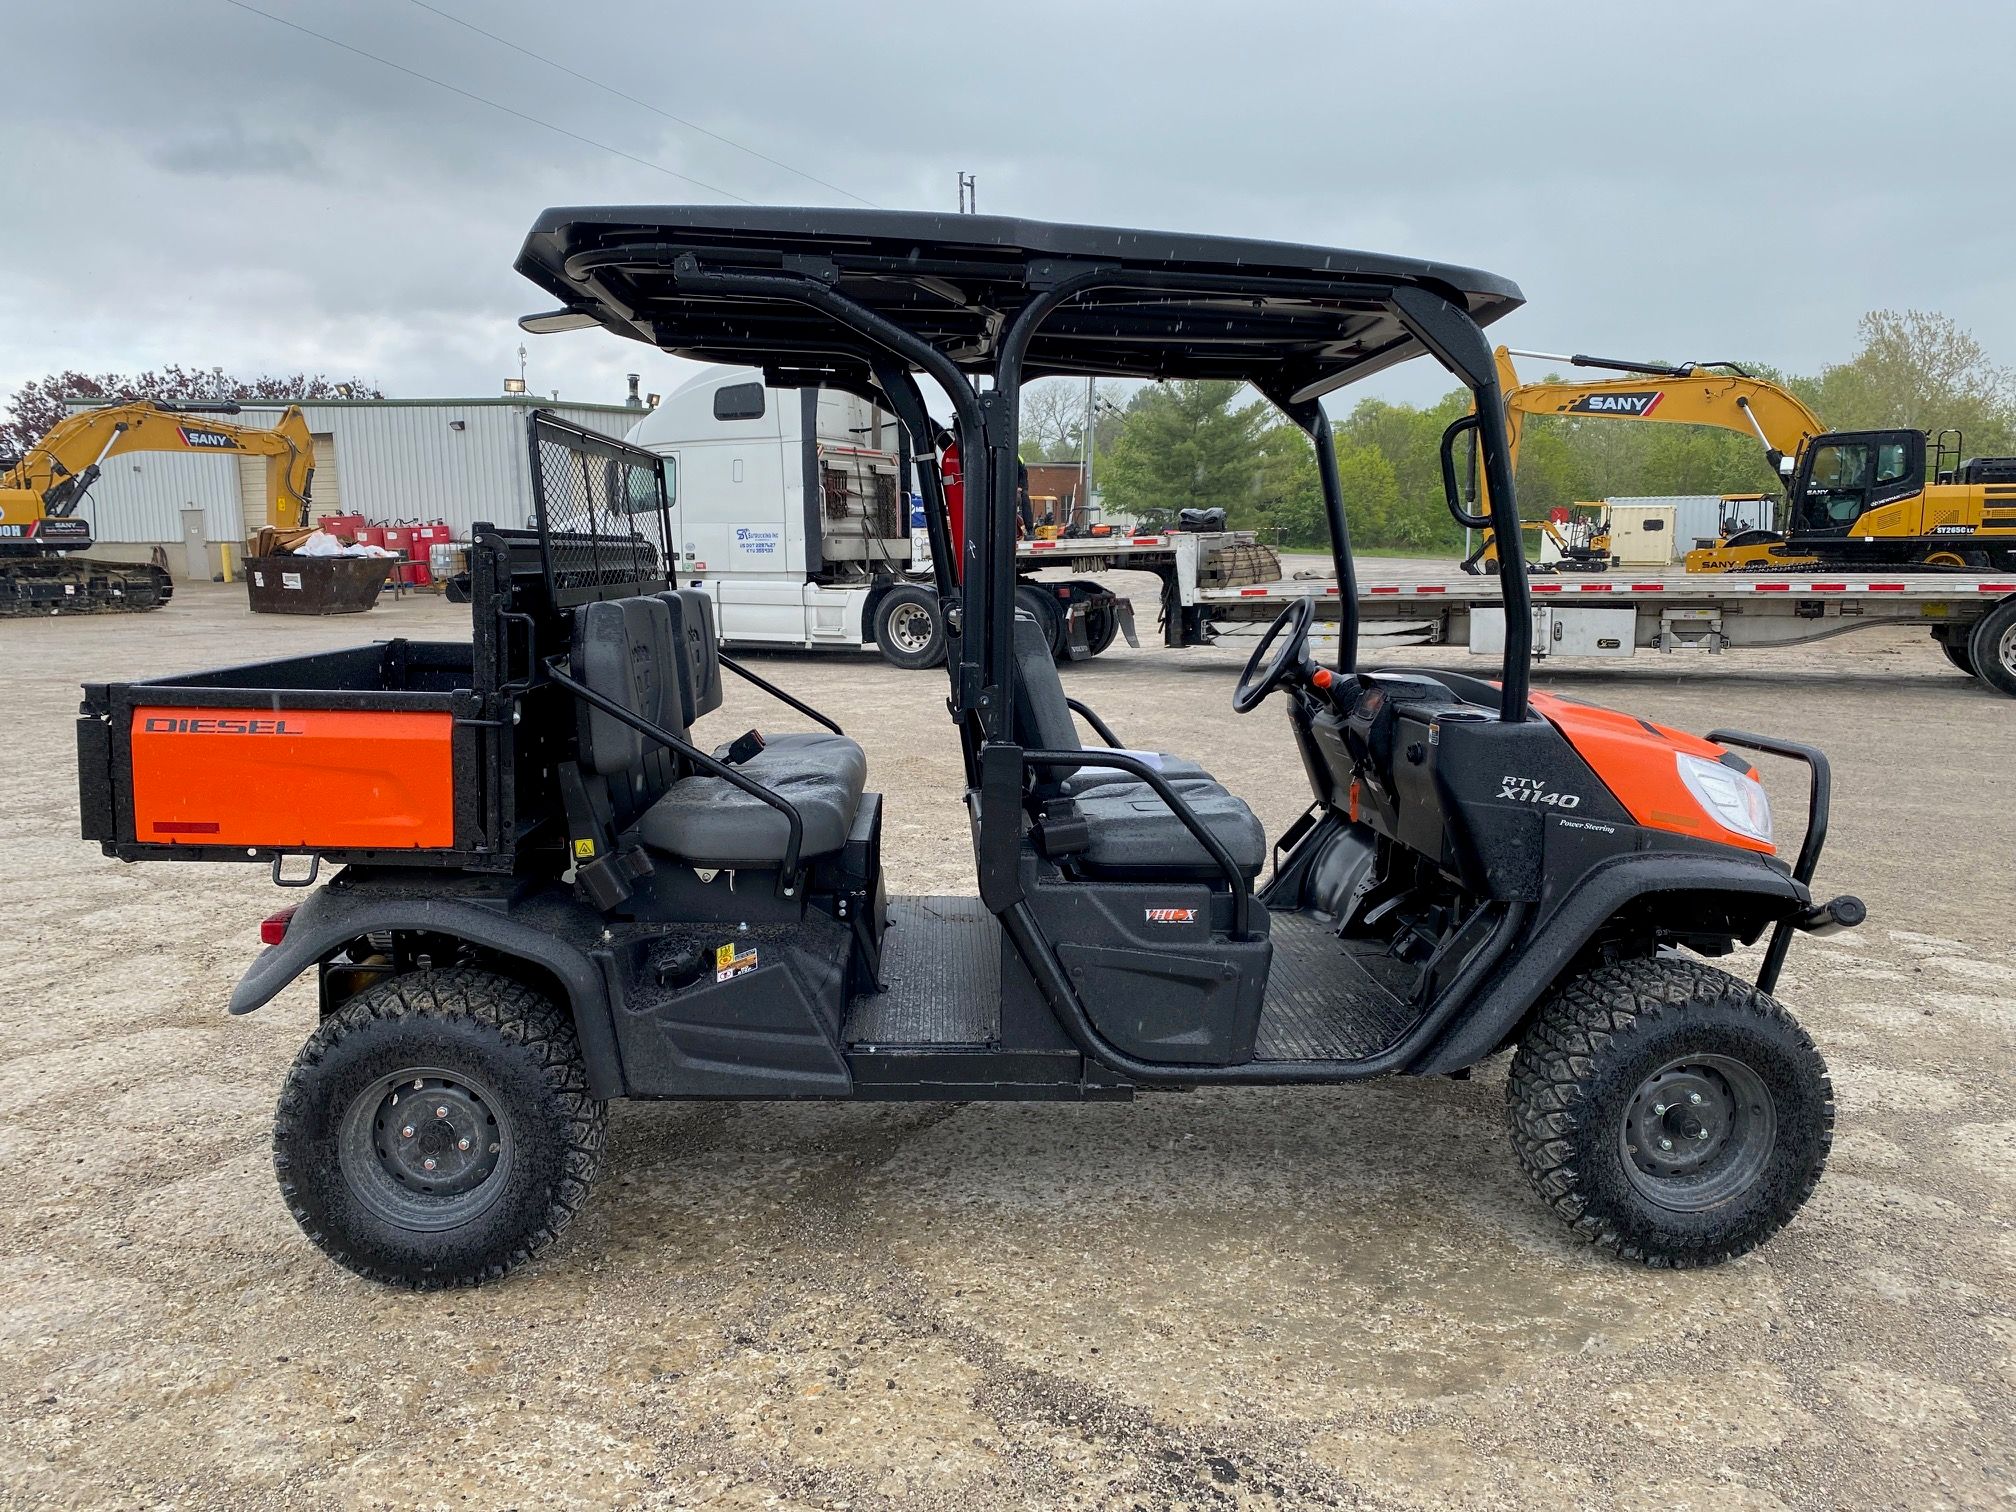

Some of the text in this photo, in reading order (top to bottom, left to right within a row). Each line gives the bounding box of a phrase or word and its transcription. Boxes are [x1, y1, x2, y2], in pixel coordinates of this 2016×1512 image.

[1589, 397, 1647, 410] SANY
[189, 433, 226, 446] SANY
[1702, 561, 1736, 569] SANY
[145, 718, 304, 735] DIESEL
[1502, 776, 1546, 790] RTV
[1496, 785, 1580, 809] X1140
[1559, 819, 1616, 835] Power Steering
[1144, 908, 1199, 921] VHT-X
